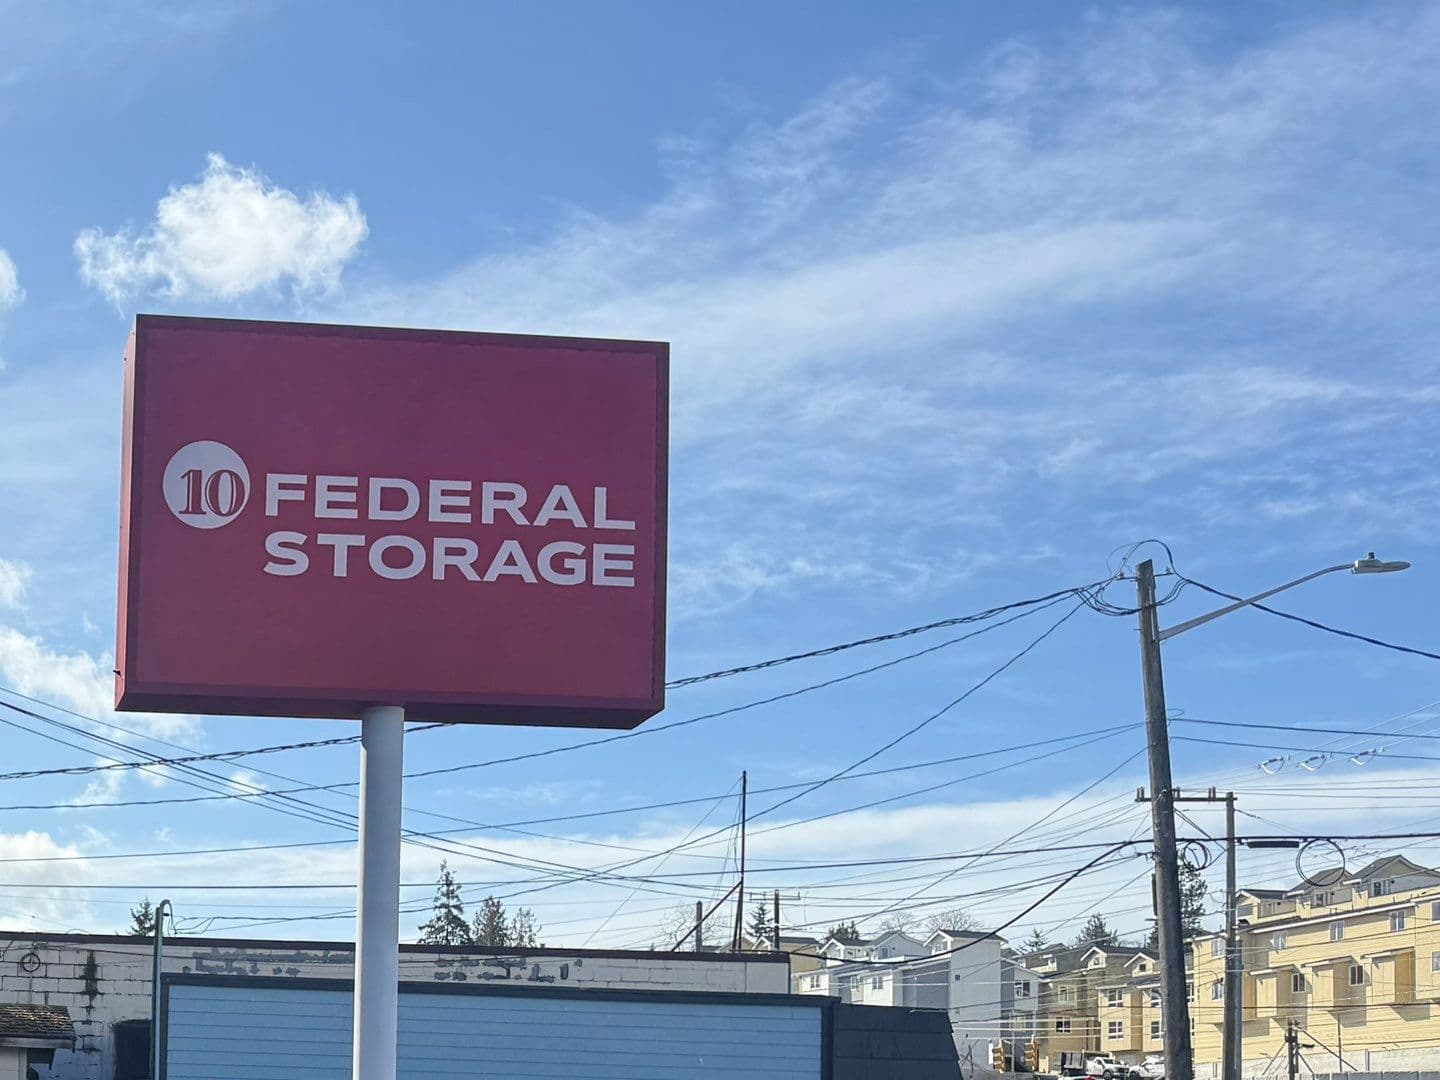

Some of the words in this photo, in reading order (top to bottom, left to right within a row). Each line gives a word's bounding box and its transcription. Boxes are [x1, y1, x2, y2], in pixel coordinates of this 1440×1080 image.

[179, 468, 246, 519] 10
[265, 472, 636, 531] FEDERAL
[263, 530, 636, 588] STORAGE
